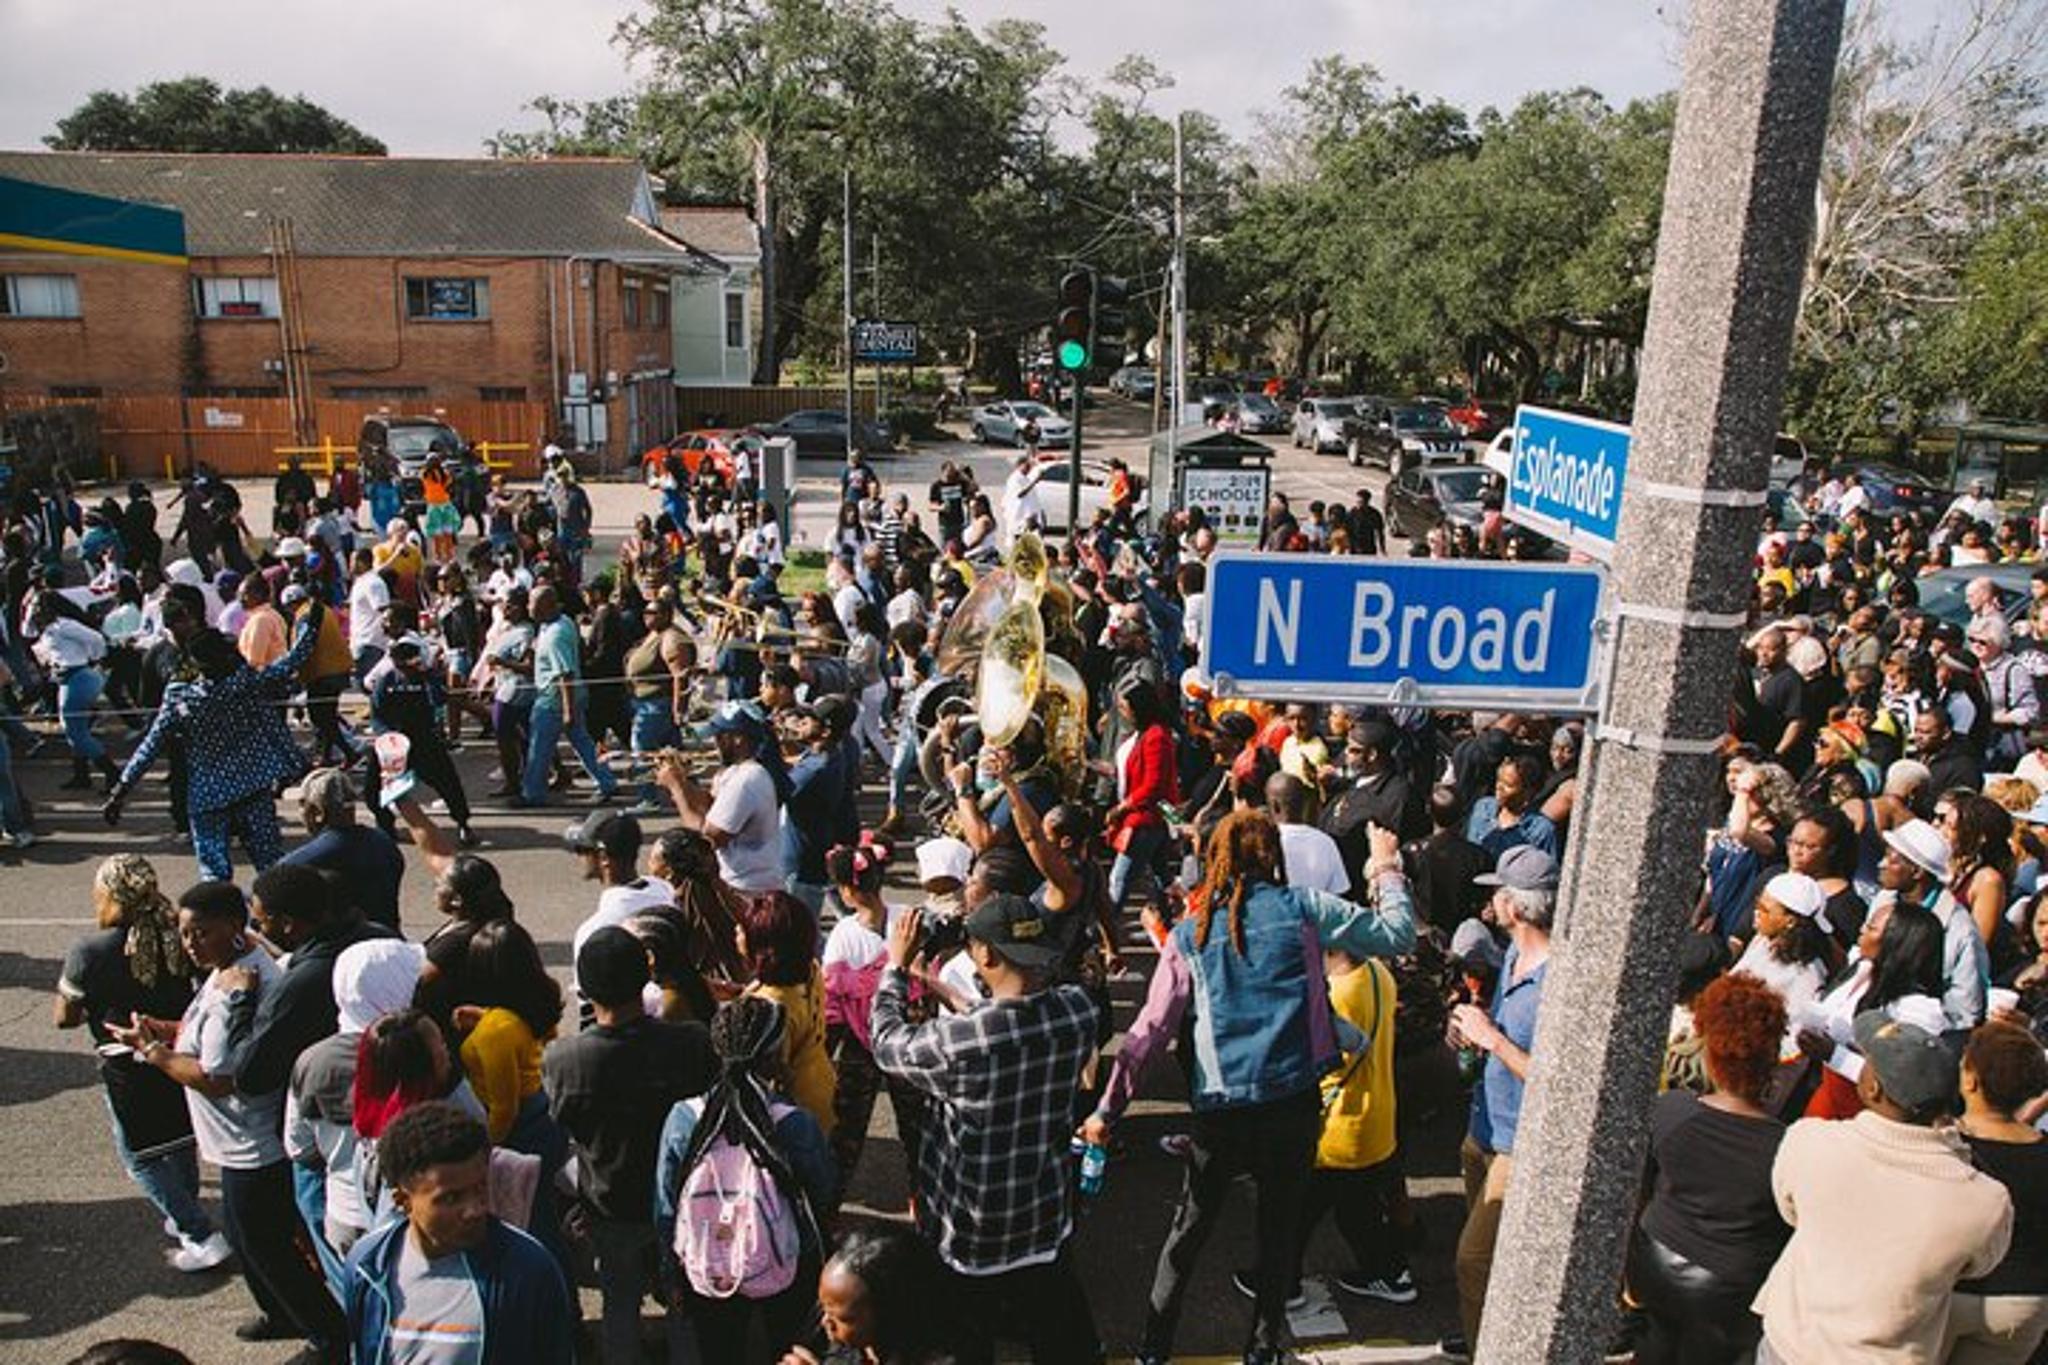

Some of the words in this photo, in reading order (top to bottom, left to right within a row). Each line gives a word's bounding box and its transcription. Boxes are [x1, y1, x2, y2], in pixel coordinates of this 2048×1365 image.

[1188, 488, 1261, 501] SCHOOLS
[1513, 427, 1615, 521] Esplanade
[1254, 577, 1303, 666] N
[1348, 579, 1556, 673] Broad
